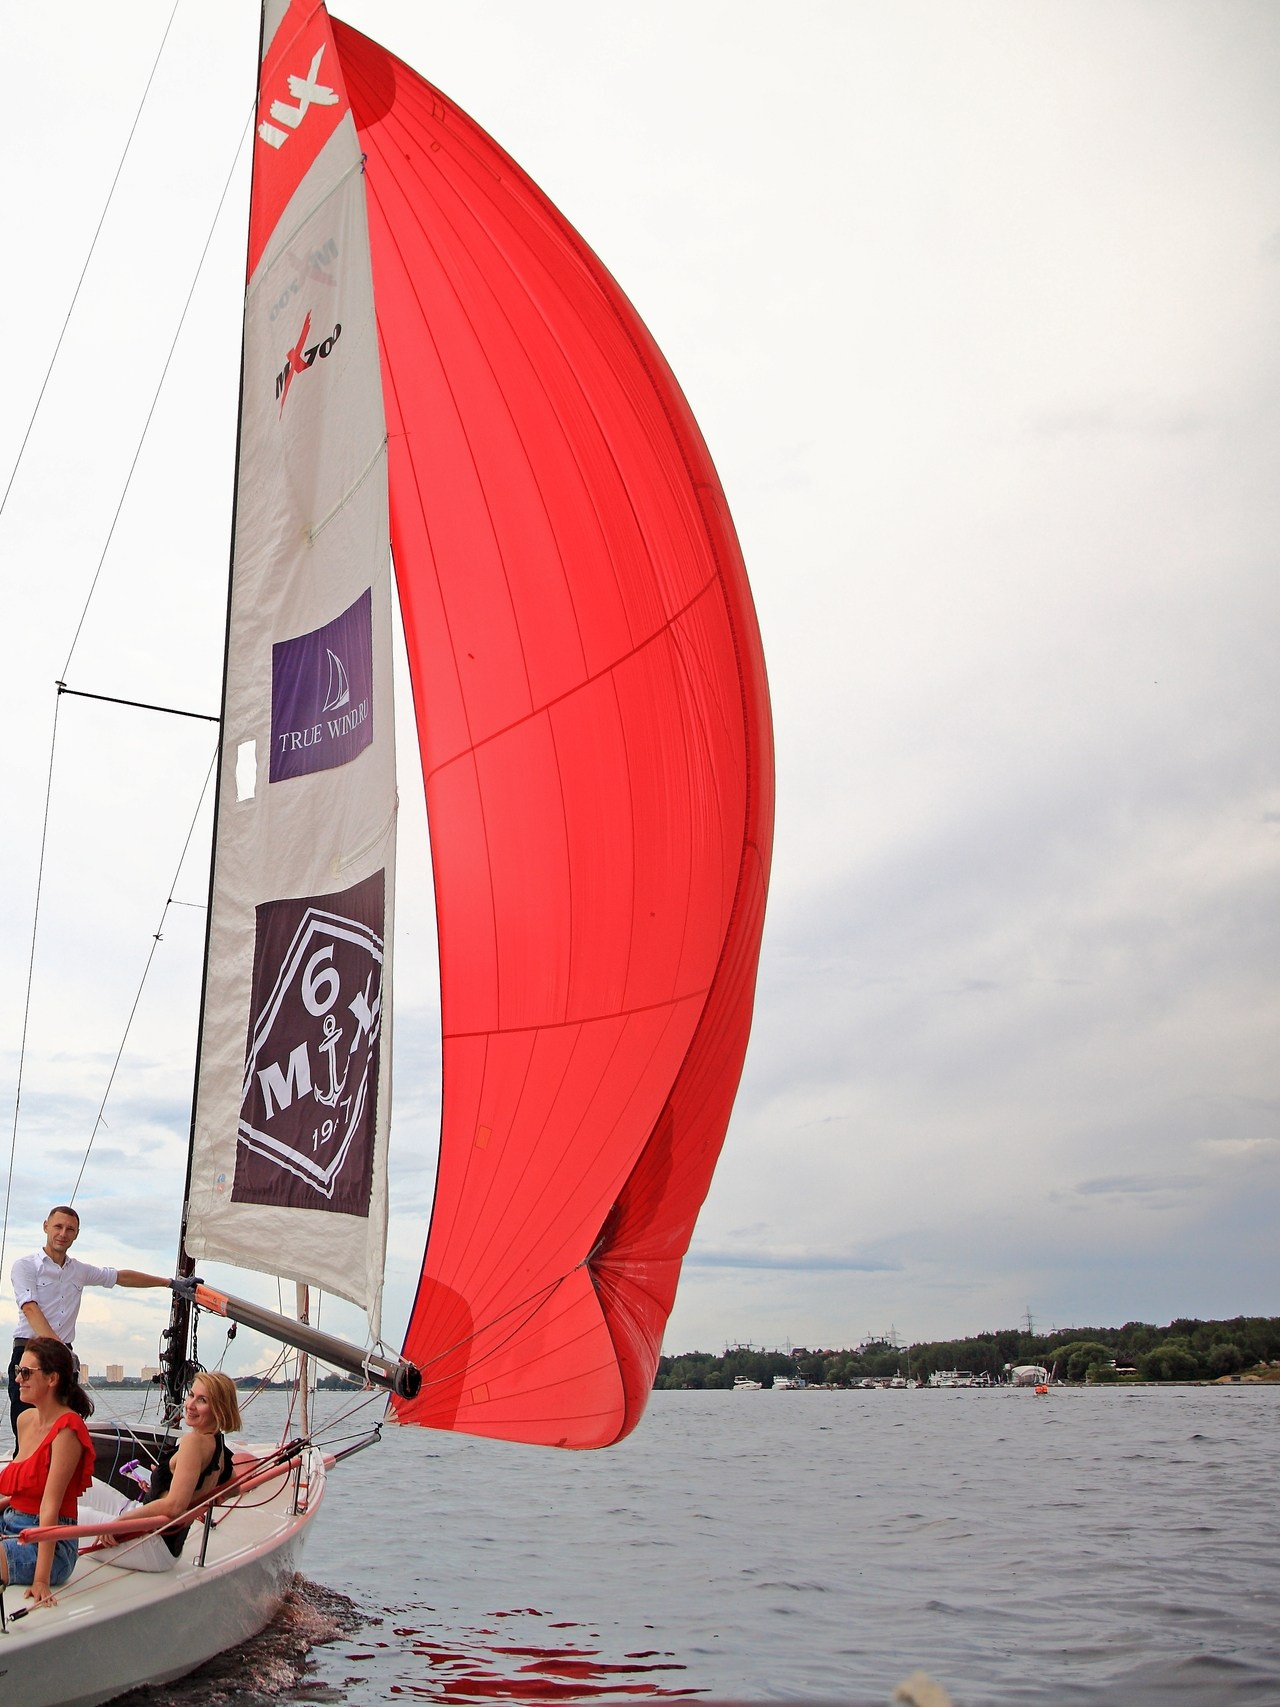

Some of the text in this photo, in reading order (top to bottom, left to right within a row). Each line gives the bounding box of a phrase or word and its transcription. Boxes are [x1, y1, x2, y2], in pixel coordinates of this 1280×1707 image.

[278, 723, 322, 752] TRUE
[301, 942, 341, 1018] 6
[312, 1094, 353, 1152] 197
